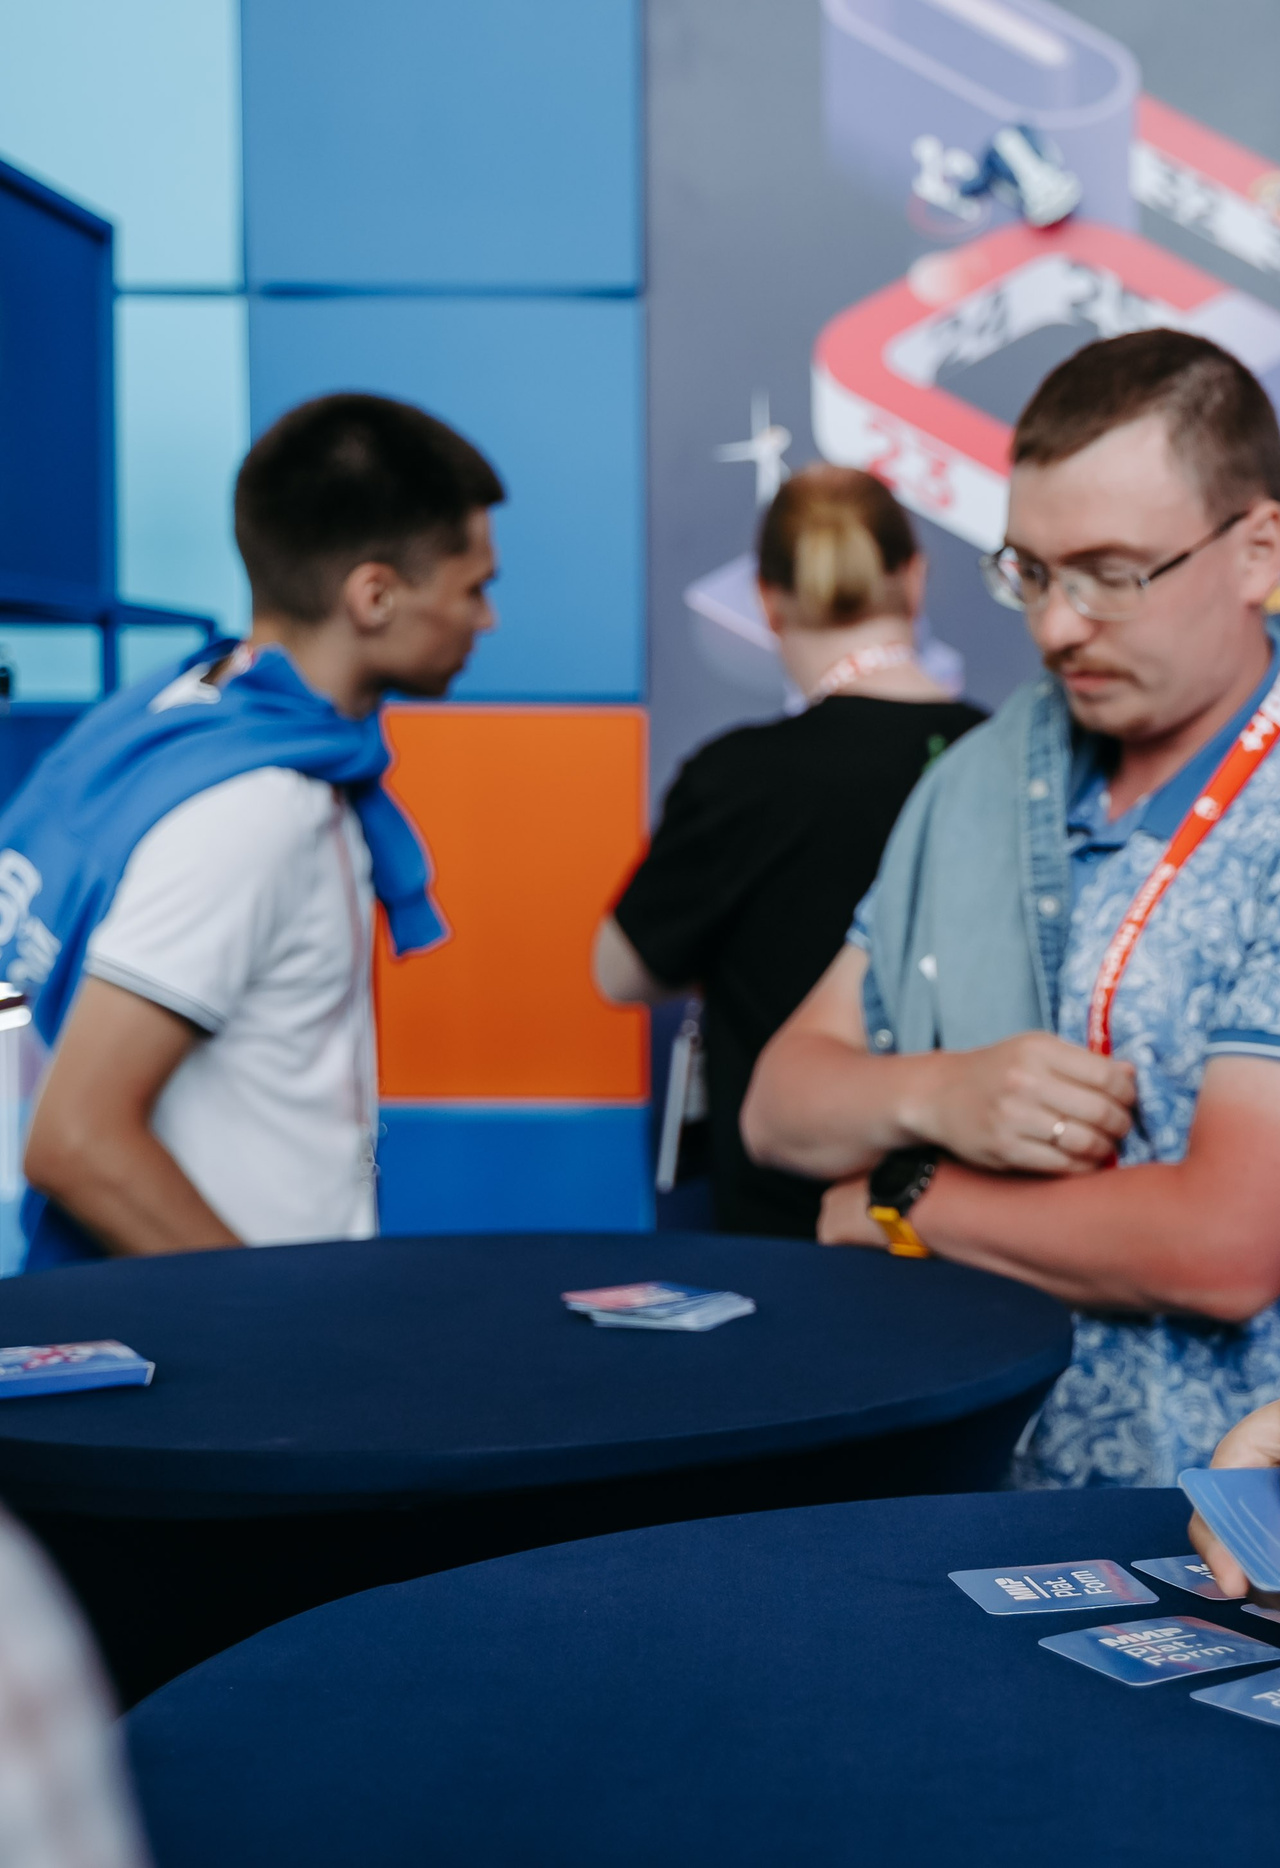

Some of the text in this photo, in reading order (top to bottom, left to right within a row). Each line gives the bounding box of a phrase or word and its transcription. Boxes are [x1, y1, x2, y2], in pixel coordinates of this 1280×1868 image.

[1070, 1570, 1113, 1595] Form
[1124, 1640, 1203, 1659] Plat.
[1142, 1644, 1236, 1667] Form
